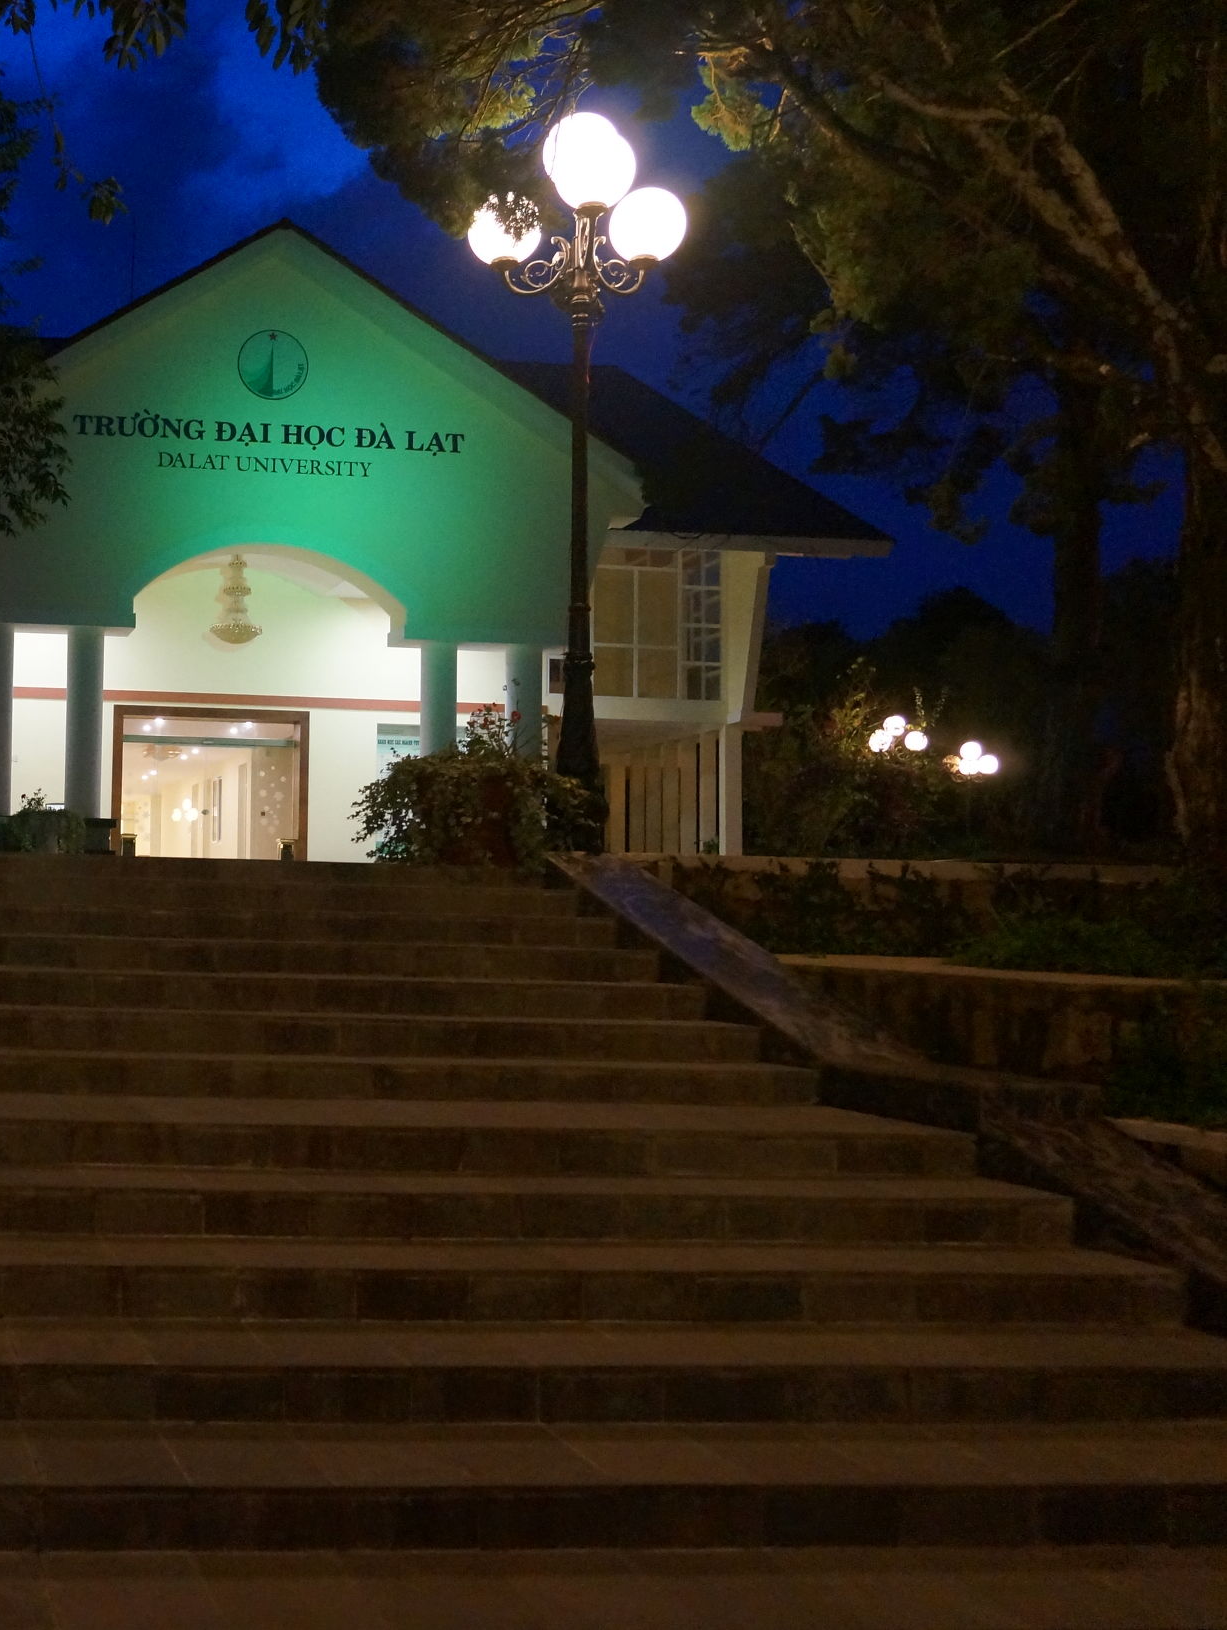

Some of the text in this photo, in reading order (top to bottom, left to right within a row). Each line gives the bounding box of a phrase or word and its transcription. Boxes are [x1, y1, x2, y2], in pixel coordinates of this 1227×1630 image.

[73, 409, 466, 457] TRƯỜNG ĐẠI HỌC ĐÀ LẠT
[157, 451, 373, 478] DALAT UNIVERSITY
